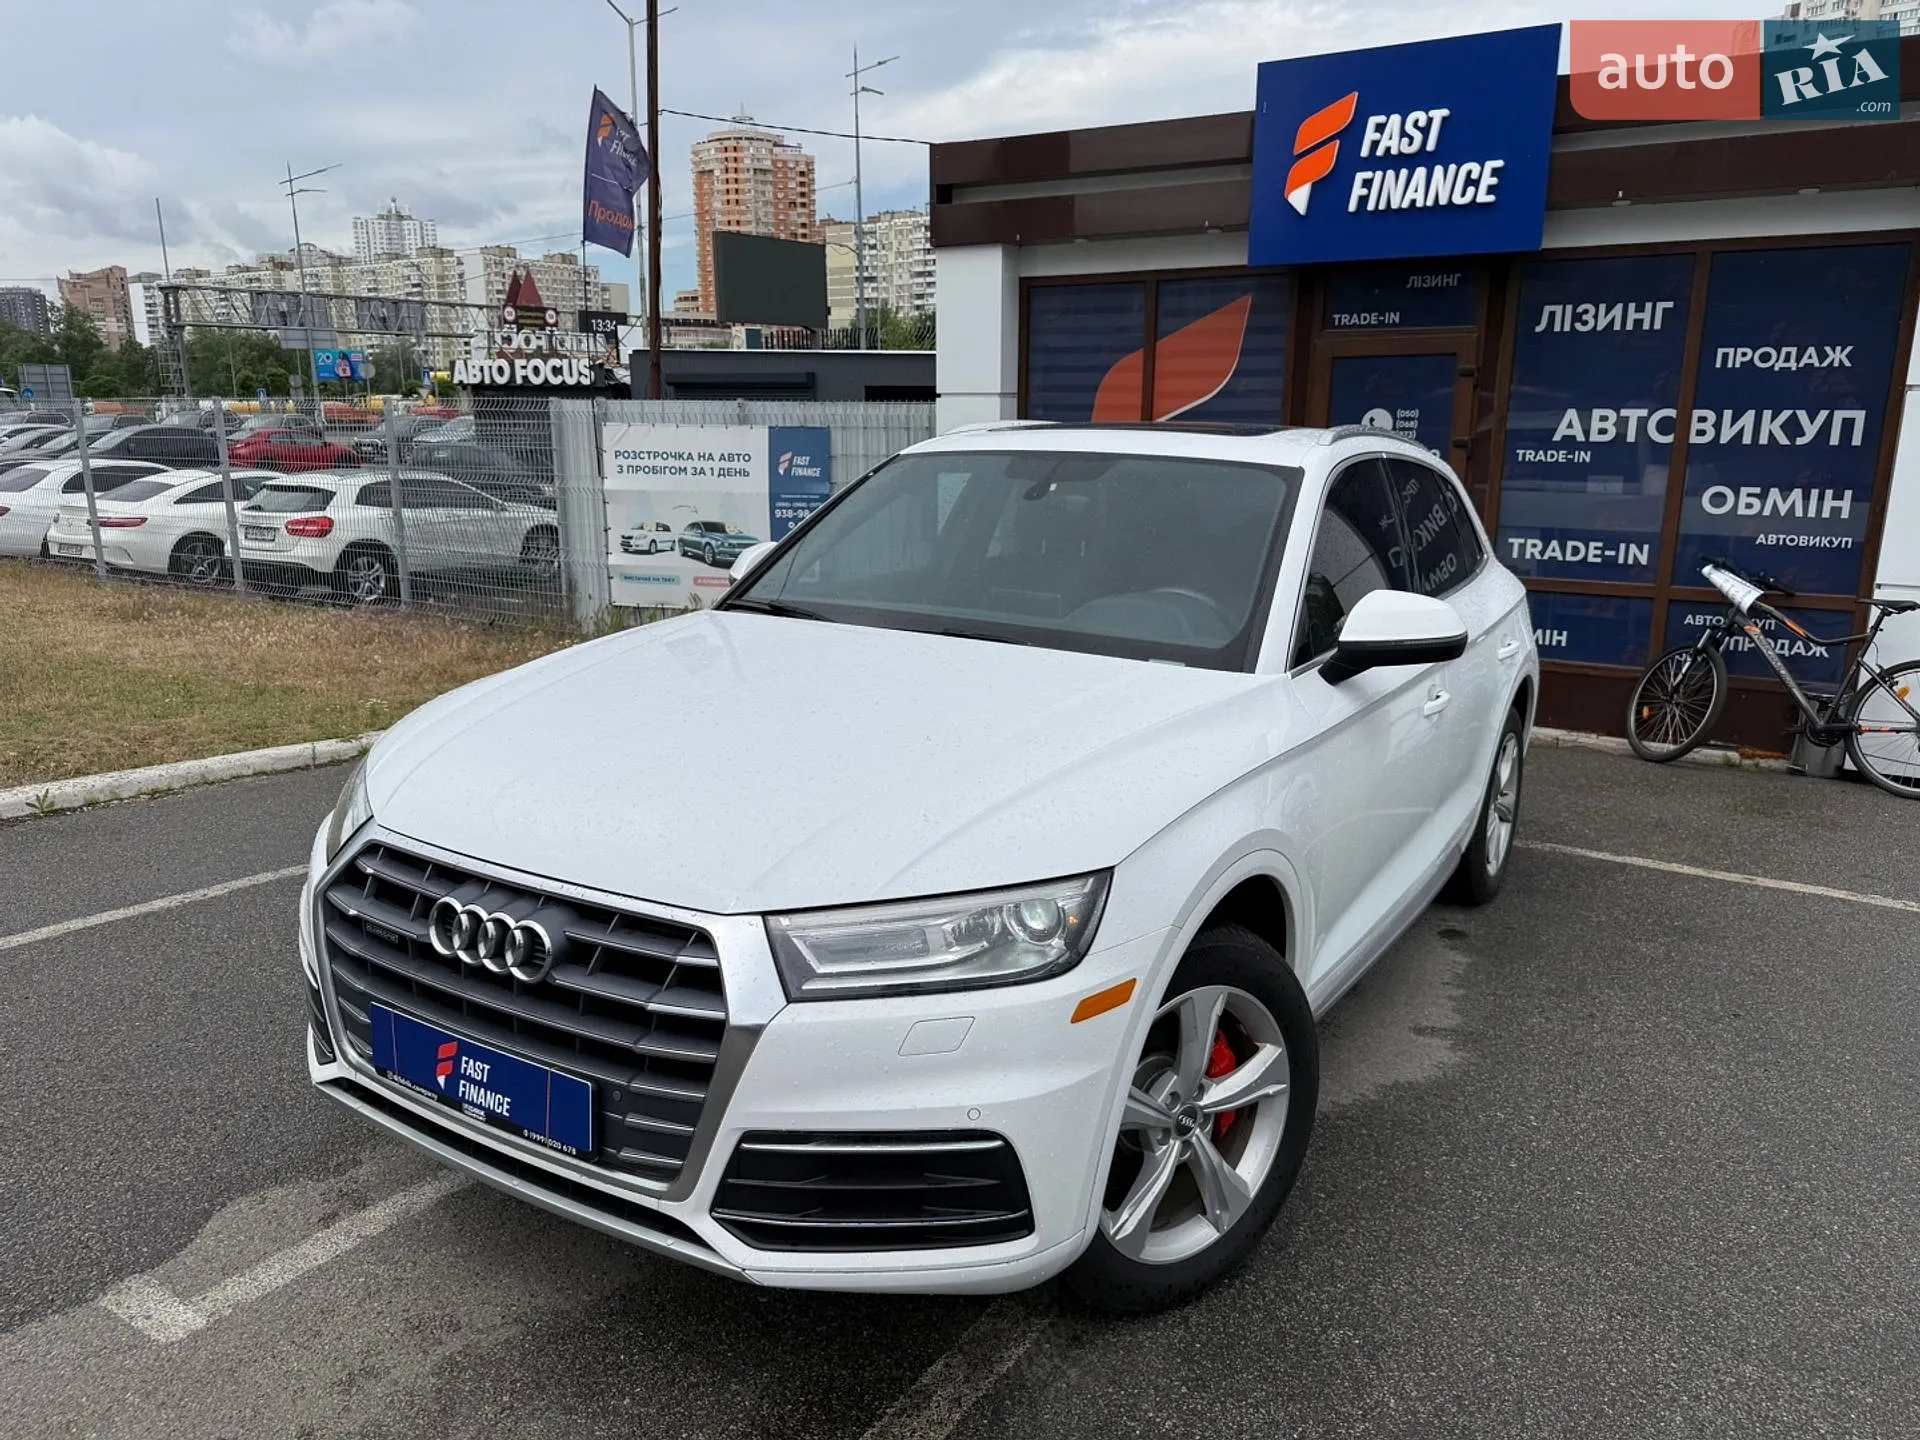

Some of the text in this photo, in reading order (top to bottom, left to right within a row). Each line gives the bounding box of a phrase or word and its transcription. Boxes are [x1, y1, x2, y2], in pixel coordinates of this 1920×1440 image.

[1360, 107, 1451, 158] FAST
[1347, 158, 1505, 213] FINANCE
[1406, 272, 1462, 290] ЛІЗИНГ
[591, 319, 617, 332] 13:34
[1332, 311, 1400, 326] TRADE-IN
[1534, 301, 1675, 333] ЛІЗИНГ
[1714, 345, 1855, 372] ПРОДАЖ
[514, 358, 596, 385] FOCUS
[1396, 408, 1420, 418] (050)
[614, 450, 752, 463] РОЗСТРОЧКА НА АВТО
[792, 455, 811, 466] FAST
[1516, 449, 1592, 464] TRADE-IN
[626, 465, 688, 476] ПРОБІГОМ
[691, 466, 707, 476] ЗА
[709, 467, 715, 476] 1
[717, 467, 751, 478] ДЕНЬ
[790, 466, 822, 477] FINANCE
[1701, 485, 1854, 520] ОБМІН
[1755, 533, 1853, 550] АВТОВИКУП
[1508, 537, 1650, 566] TRADE-IN
[461, 1055, 491, 1084] FAST
[458, 1079, 512, 1117] FINANCE
